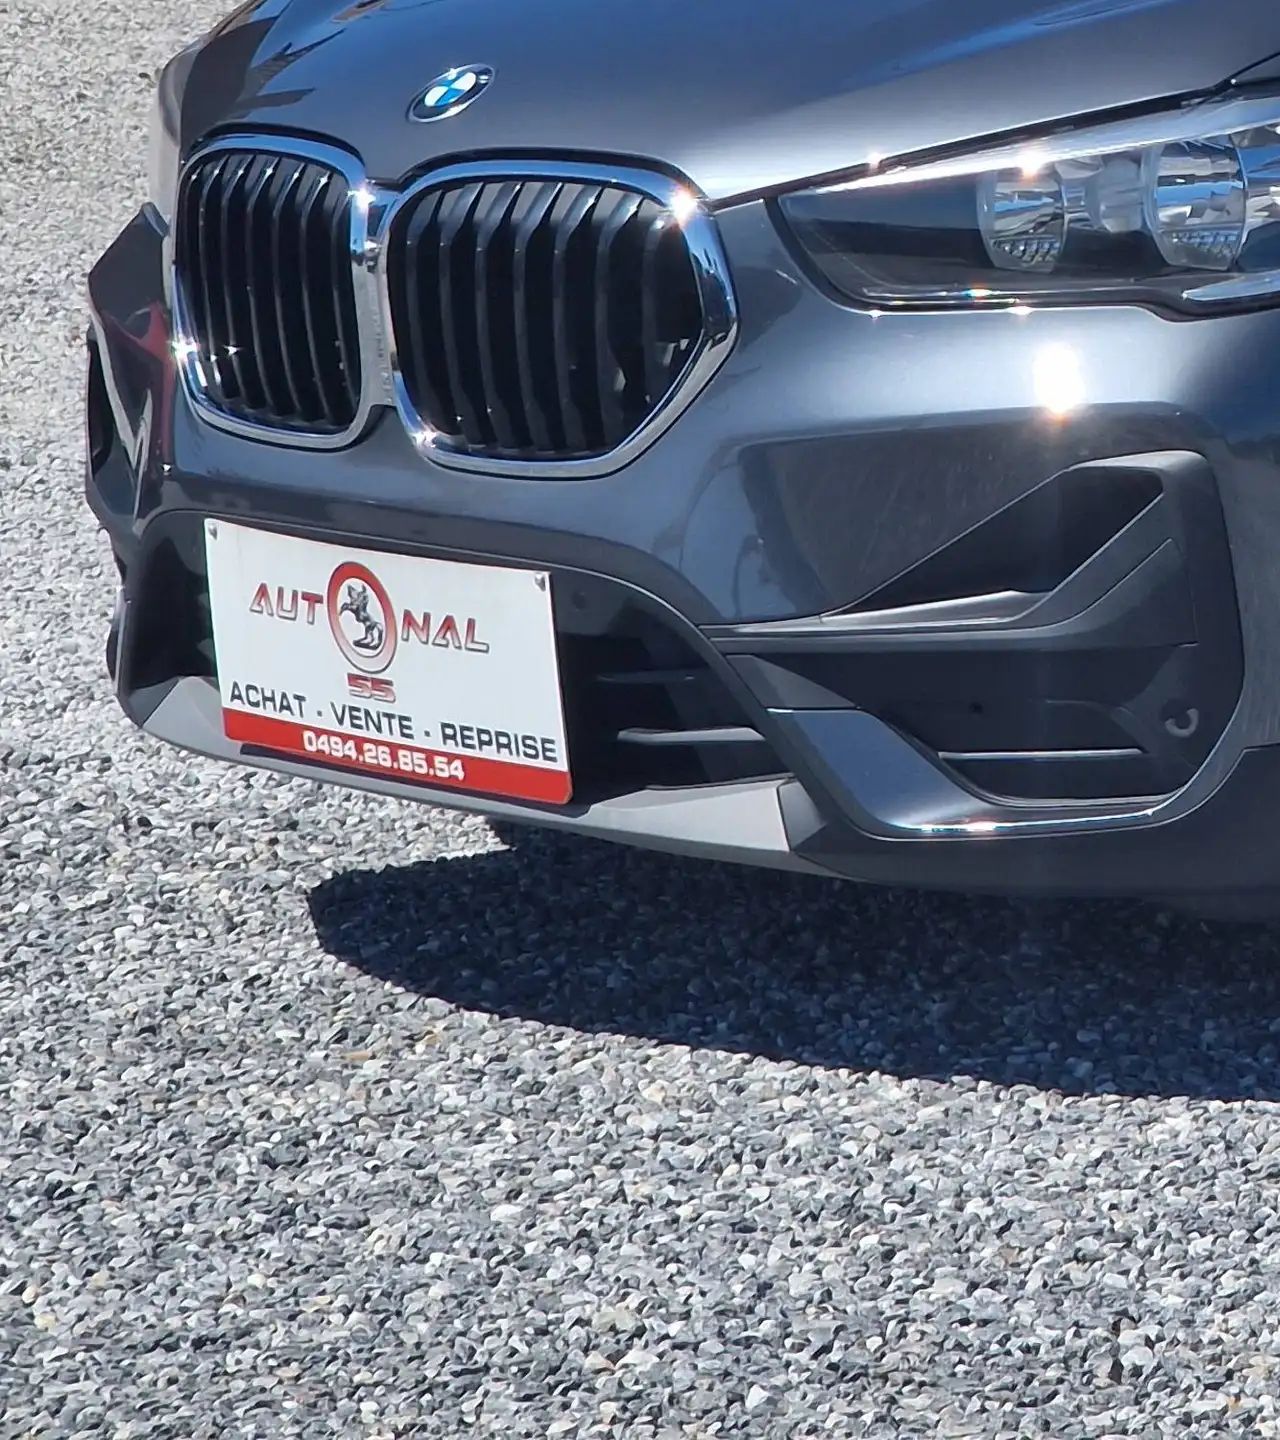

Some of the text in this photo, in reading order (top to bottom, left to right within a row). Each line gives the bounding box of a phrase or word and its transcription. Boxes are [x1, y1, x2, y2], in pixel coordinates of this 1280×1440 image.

[346, 674, 397, 704] 55
[229, 681, 559, 763] ACHAT VENTE REPRISE
[302, 729, 466, 782] 0494.26.85.54
